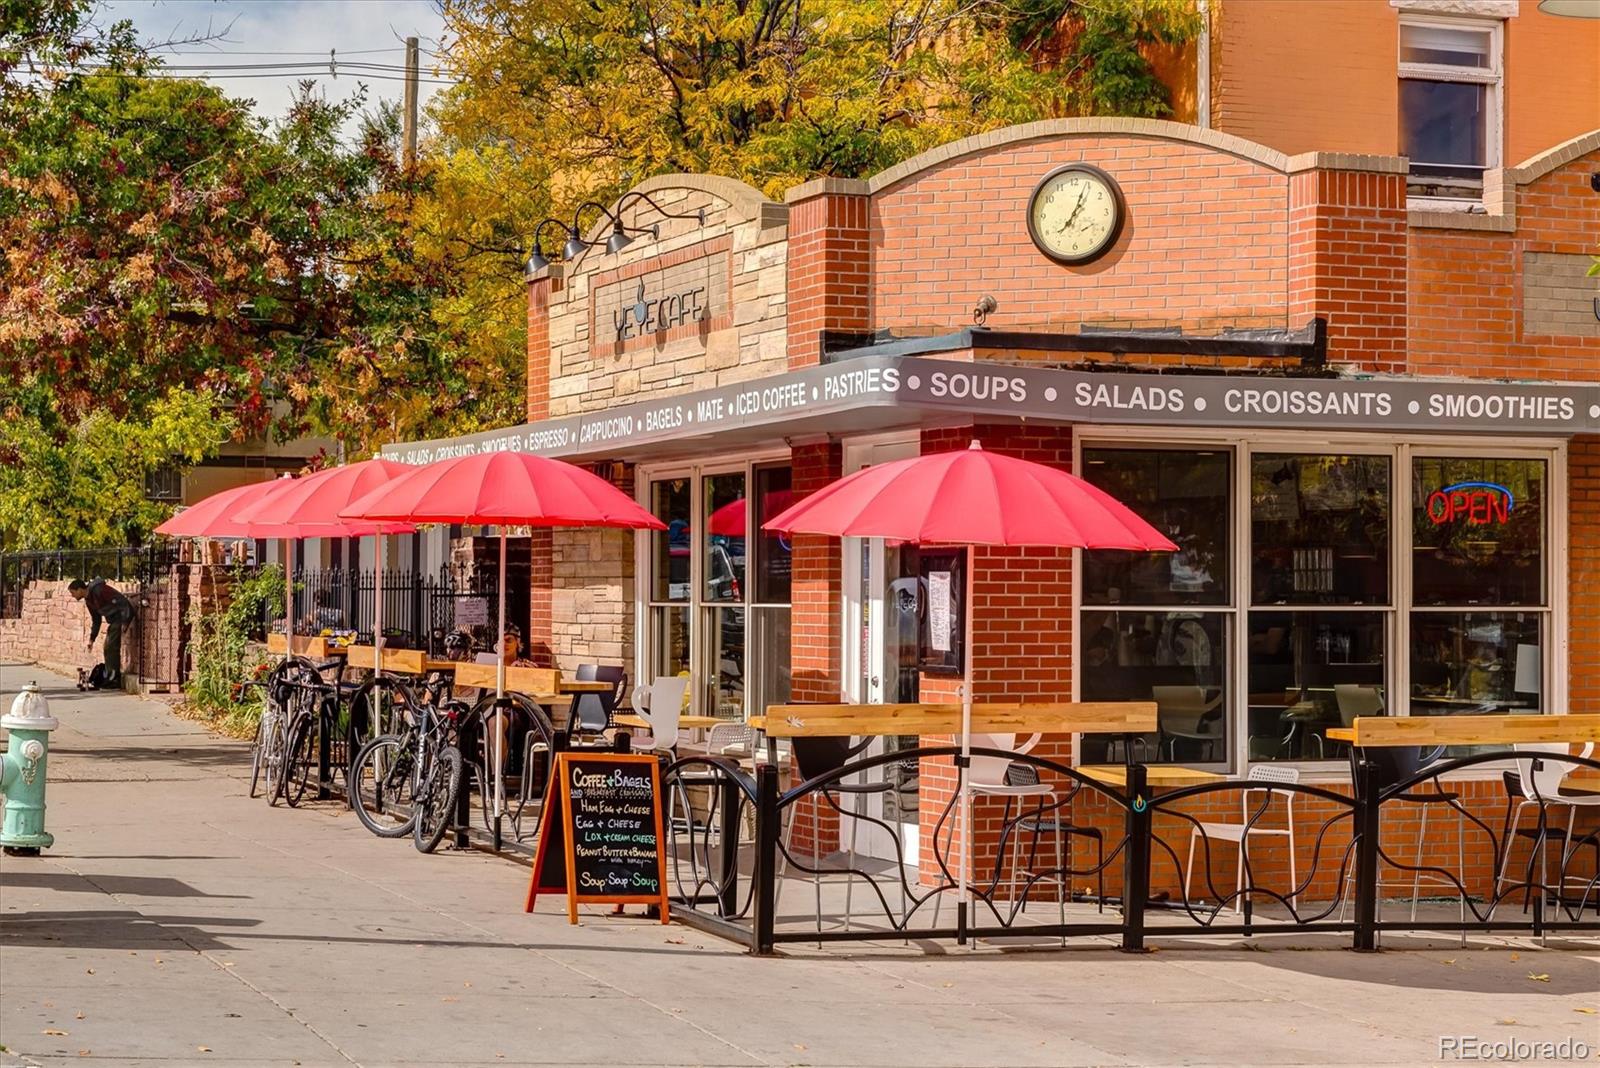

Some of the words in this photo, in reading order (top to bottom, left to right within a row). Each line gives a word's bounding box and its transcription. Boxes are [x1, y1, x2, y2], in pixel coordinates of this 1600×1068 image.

[929, 371, 1028, 403] SOUPS
[1074, 381, 1185, 412] SALADS
[1223, 388, 1393, 417] CROISSANTS
[1428, 393, 1575, 421] SMOOTHIES
[406, 448, 430, 465] SALADS
[529, 427, 568, 451] ESPRESSO
[580, 415, 633, 443] CAPPUCCINO
[646, 405, 683, 432] BAGELS
[697, 398, 723, 422] MATE
[736, 382, 761, 415] ICED
[763, 383, 807, 413] COFFEE
[824, 367, 900, 400] PASTRIES
[1427, 491, 1508, 525] OPEN
[623, 805, 651, 815] CHEESE
[575, 814, 594, 828] EGG
[607, 818, 641, 829] CHEESE
[585, 831, 602, 842] LOX
[631, 834, 656, 844] CHEESE
[576, 844, 601, 857] PEANUT
